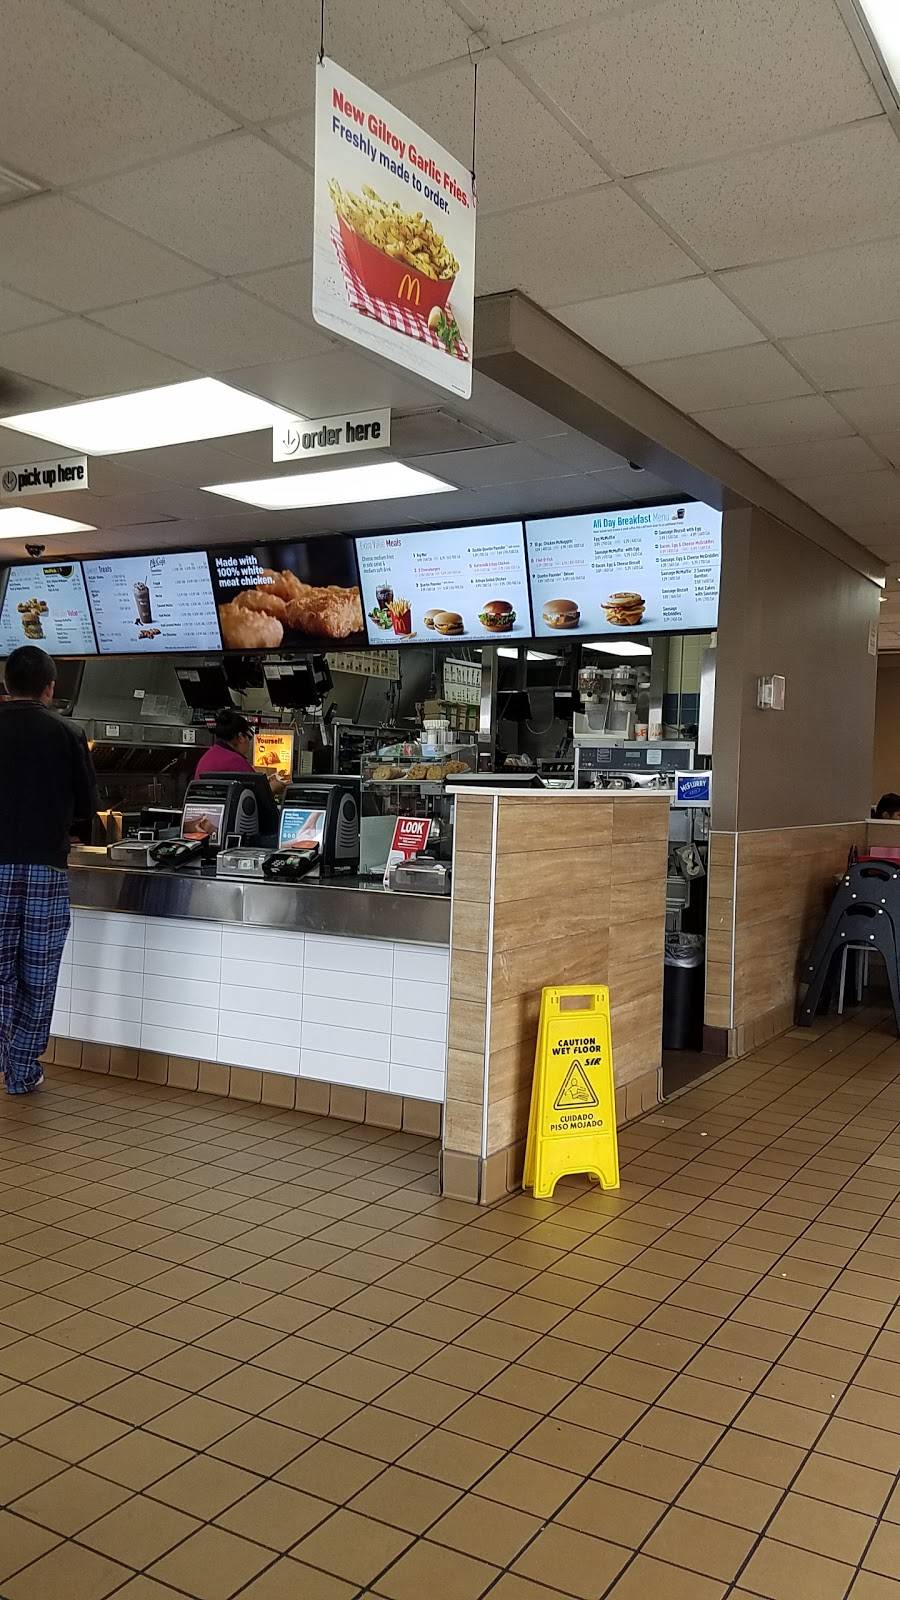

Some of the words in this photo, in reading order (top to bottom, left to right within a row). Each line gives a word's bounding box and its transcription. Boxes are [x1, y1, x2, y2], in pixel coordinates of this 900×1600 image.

[333, 88, 365, 126] New
[368, 114, 406, 159] Gilroy
[408, 145, 441, 184] Garlic
[444, 172, 470, 208] Fries.
[333, 115, 377, 162] Freshly
[380, 153, 409, 183] made
[412, 173, 422, 192] to
[424, 184, 450, 215] order.
[302, 425, 342, 449] order
[346, 422, 380, 443] here
[18, 467, 40, 491] pick
[43, 469, 56, 488] up
[58, 464, 84, 482] here
[593, 520, 601, 528] All
[604, 519, 615, 528] Day
[618, 514, 650, 525] Breakfast
[653, 513, 669, 521] Menu
[386, 539, 401, 547] Meals
[215, 557, 238, 567] Made
[239, 555, 257, 565] with
[217, 567, 240, 577] 100%
[241, 565, 264, 575] white
[219, 577, 240, 587] meat
[241, 575, 275, 585] chicken.
[401, 821, 425, 834] LOOK
[558, 1038, 595, 1047] CAUTION
[552, 1048, 570, 1056] WET
[574, 1046, 601, 1054] FLOOR
[585, 1057, 601, 1066] SIR
[560, 1114, 593, 1123] CUIDADO
[551, 1123, 568, 1131] PISO
[570, 1120, 603, 1128] MOJADO
